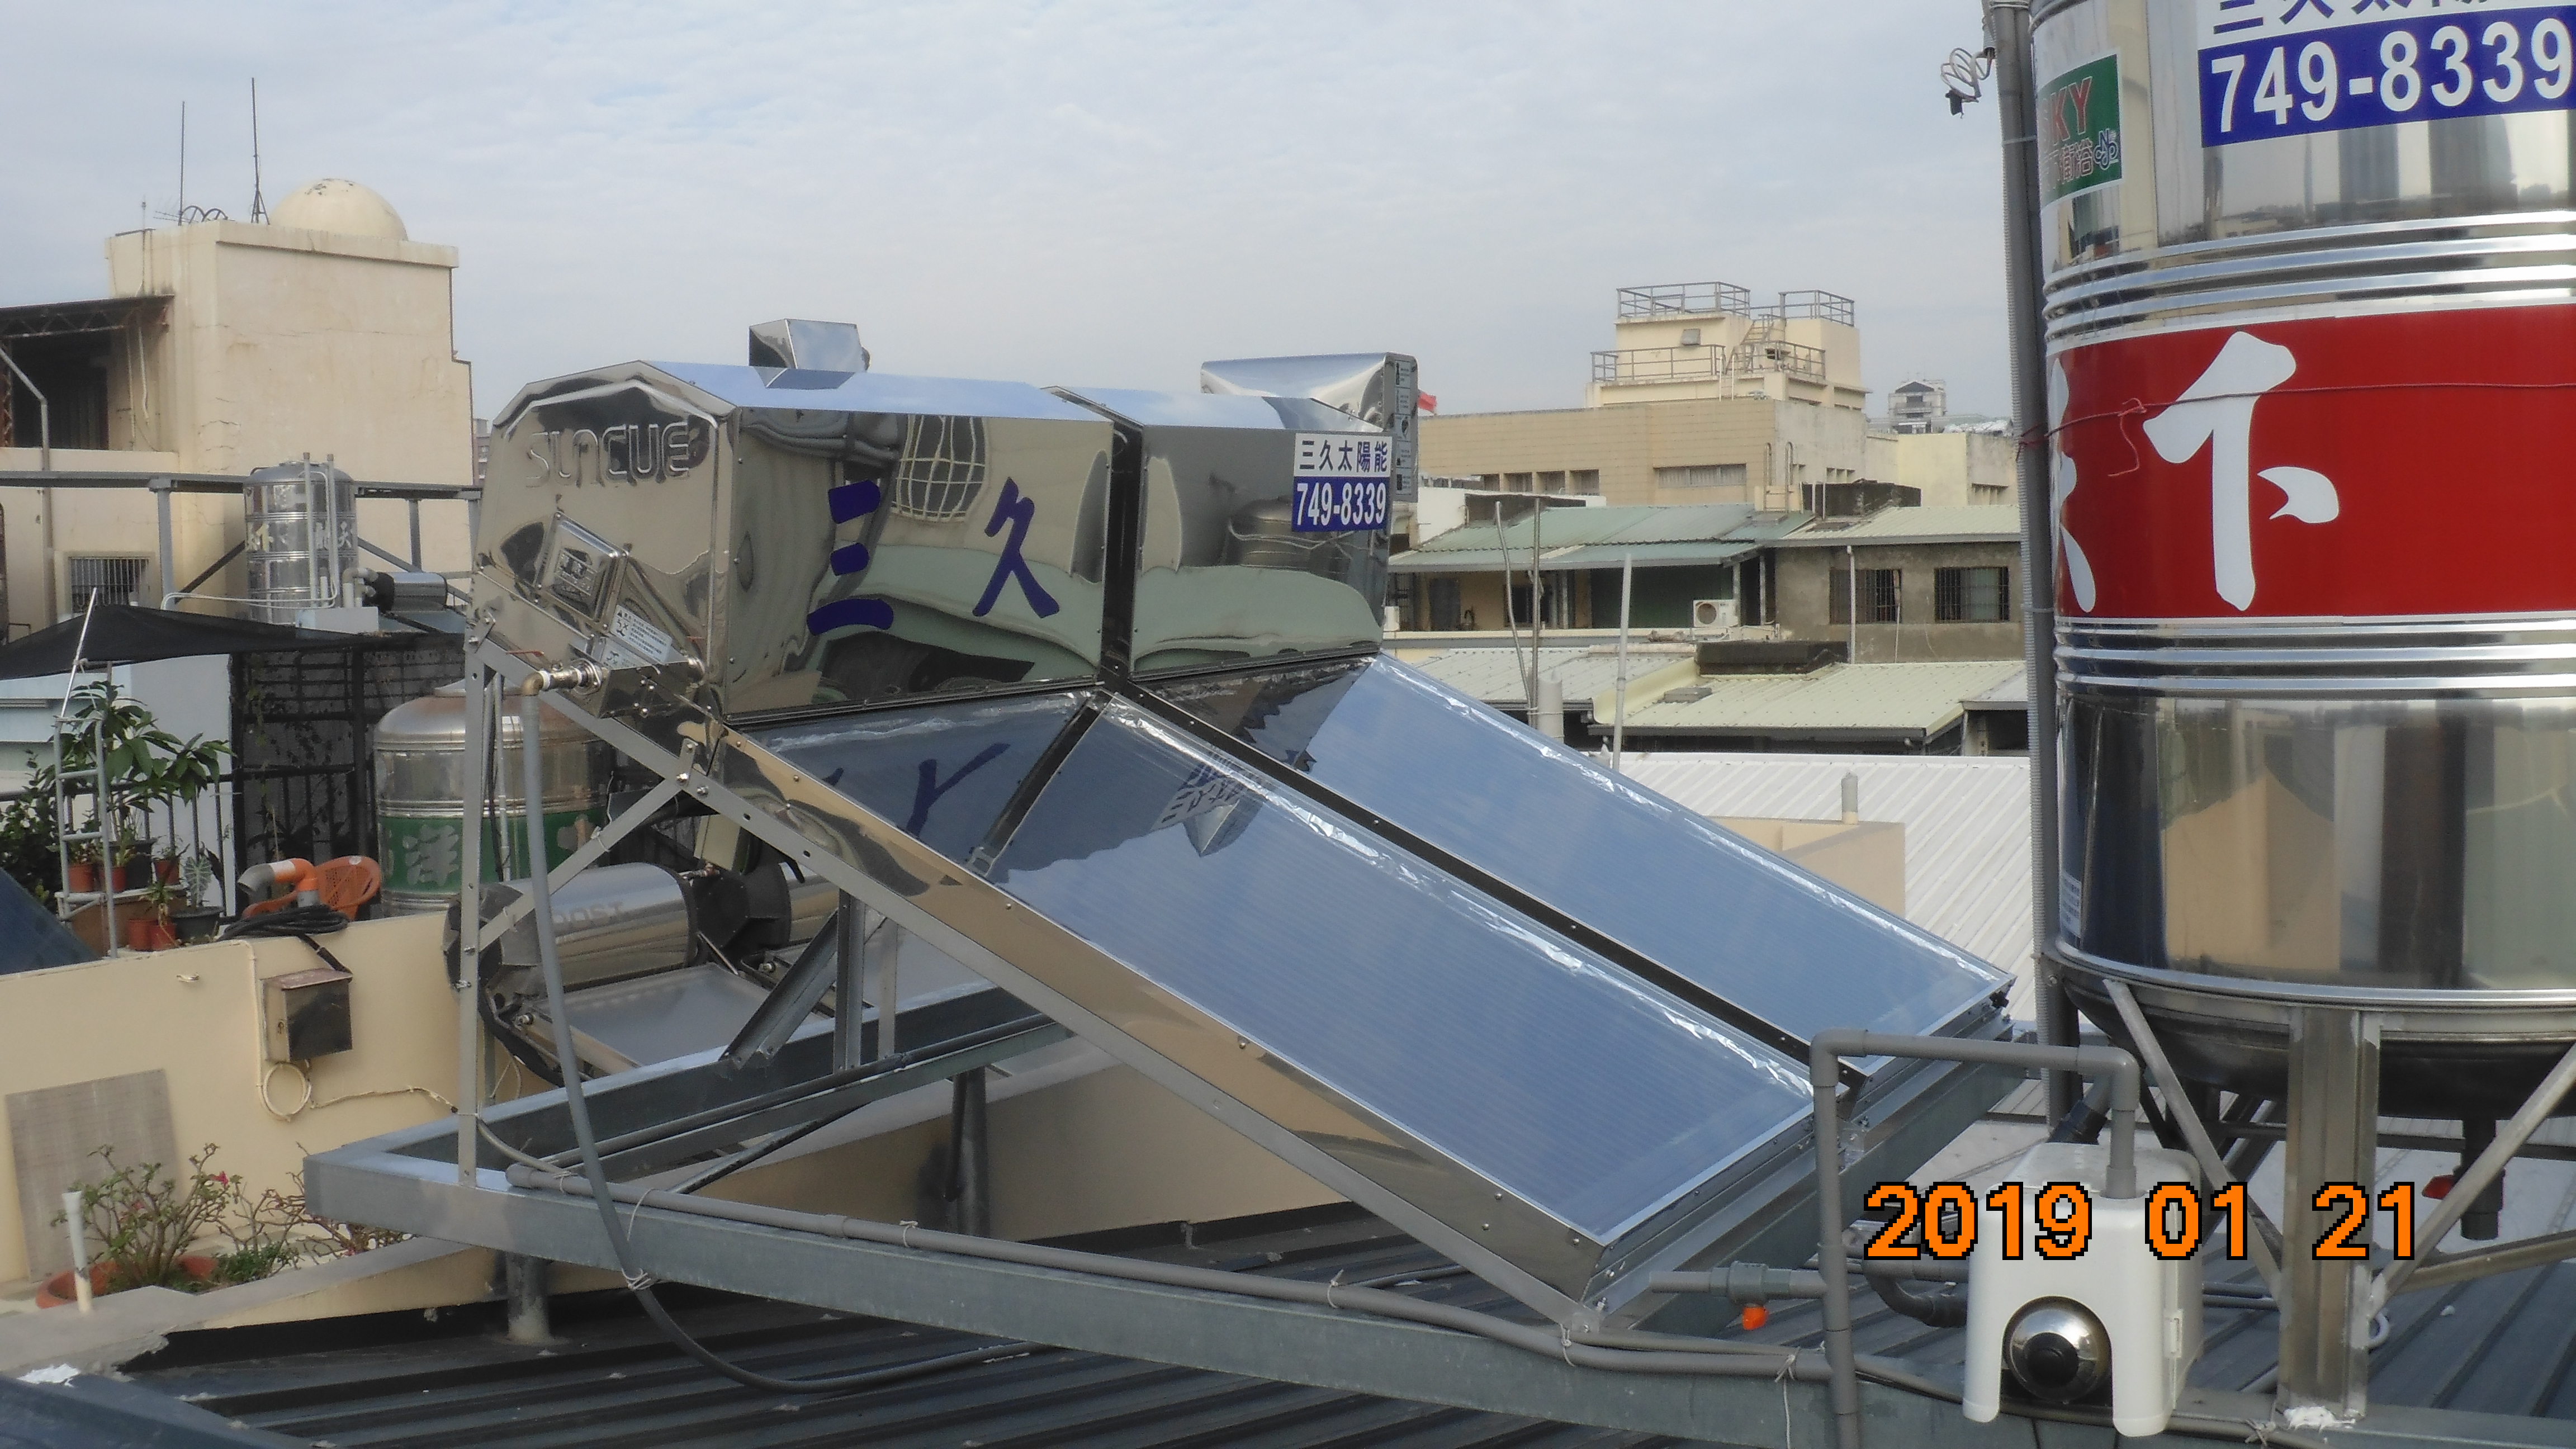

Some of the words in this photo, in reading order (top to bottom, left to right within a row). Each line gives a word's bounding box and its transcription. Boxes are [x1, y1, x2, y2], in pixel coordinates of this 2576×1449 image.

[2212, 18, 2572, 132] 749-8339
[1300, 440, 1388, 472] 三久太陽能
[1296, 482, 1386, 525] 749-8339
